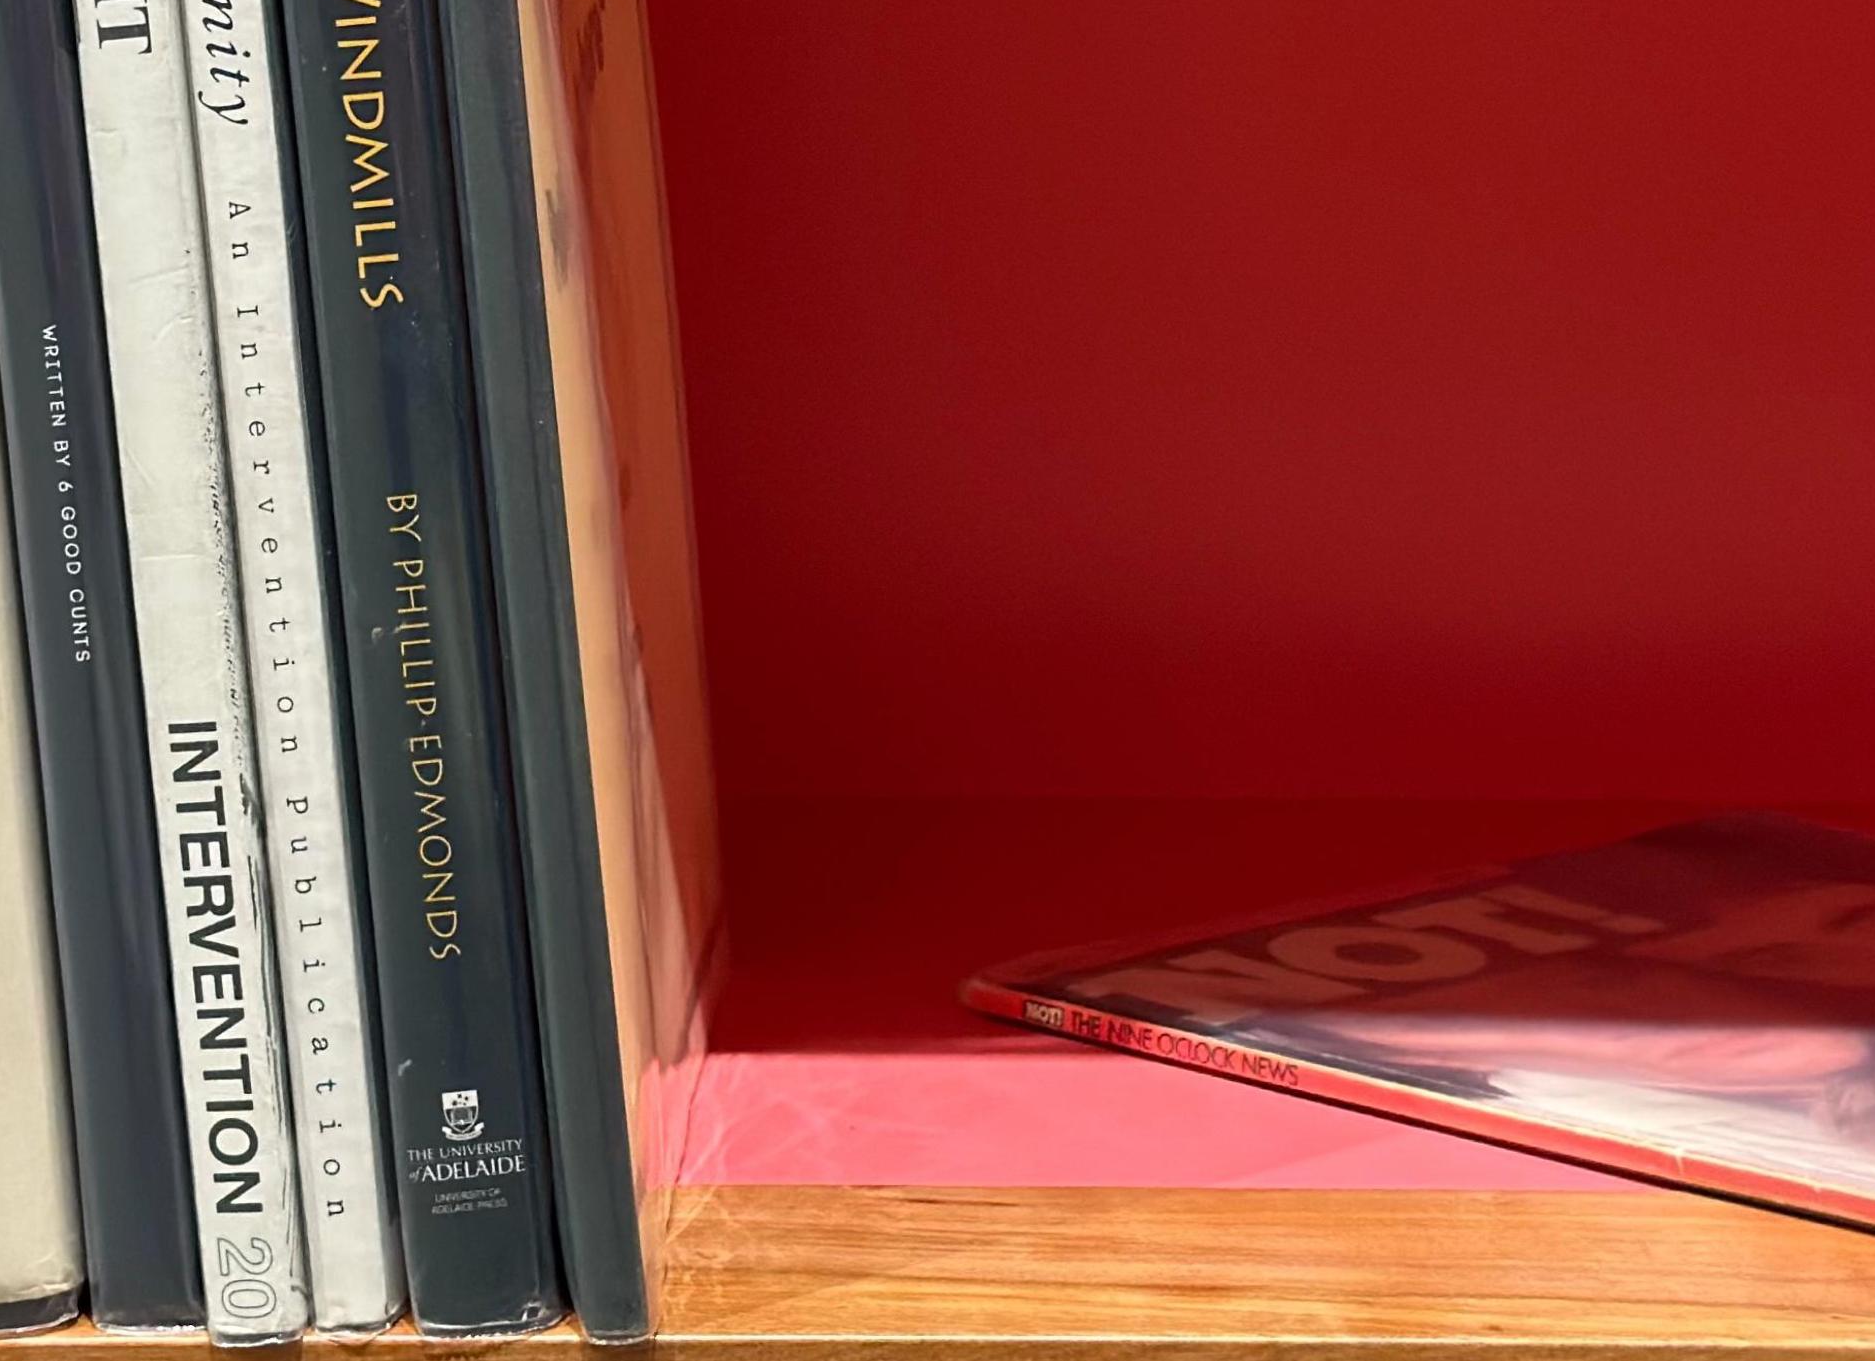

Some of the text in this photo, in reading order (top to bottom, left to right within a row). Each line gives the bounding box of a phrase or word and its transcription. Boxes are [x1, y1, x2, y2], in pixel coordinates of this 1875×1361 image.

[41, 324, 92, 663] WRITTEN BY 6 GOOD CUNTS
[229, 201, 345, 1218] An Intervention Publication
[386, 493, 461, 961] BY PHILLIP EDMONDS
[167, 721, 277, 1318] INTERVENTION 20
[1063, 884, 1666, 1026] NOT!
[1070, 1011, 1101, 1038] THE
[1106, 1020, 1153, 1049] NINE
[1241, 1055, 1299, 1086] NEWS
[407, 1139, 522, 1160] THE UNIVERSITY
[422, 1155, 526, 1182] ADELAIDE
